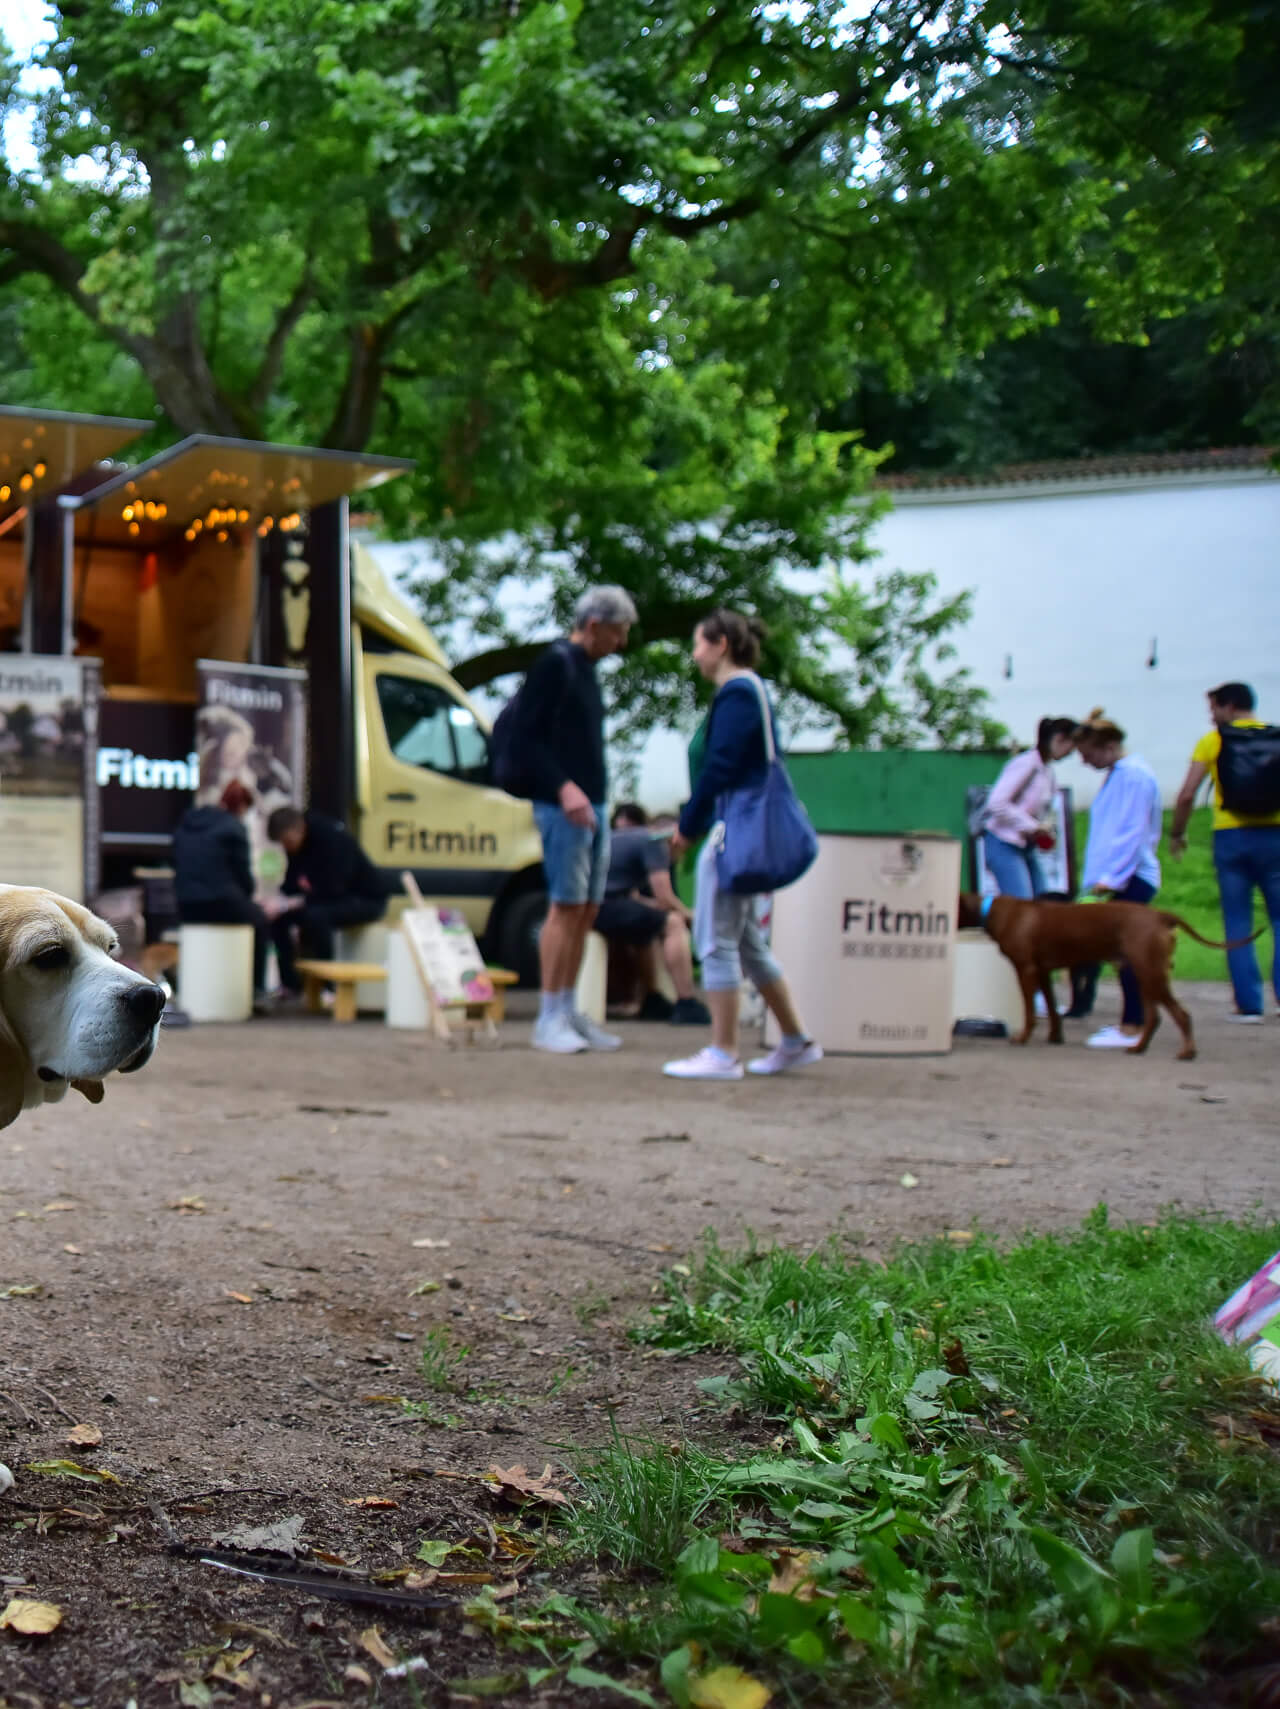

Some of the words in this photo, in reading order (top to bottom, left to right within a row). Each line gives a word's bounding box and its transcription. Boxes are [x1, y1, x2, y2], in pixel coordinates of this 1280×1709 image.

[96, 746, 200, 790] Fitmi
[386, 821, 498, 855] Fitmin
[842, 899, 949, 934] Fitmin
